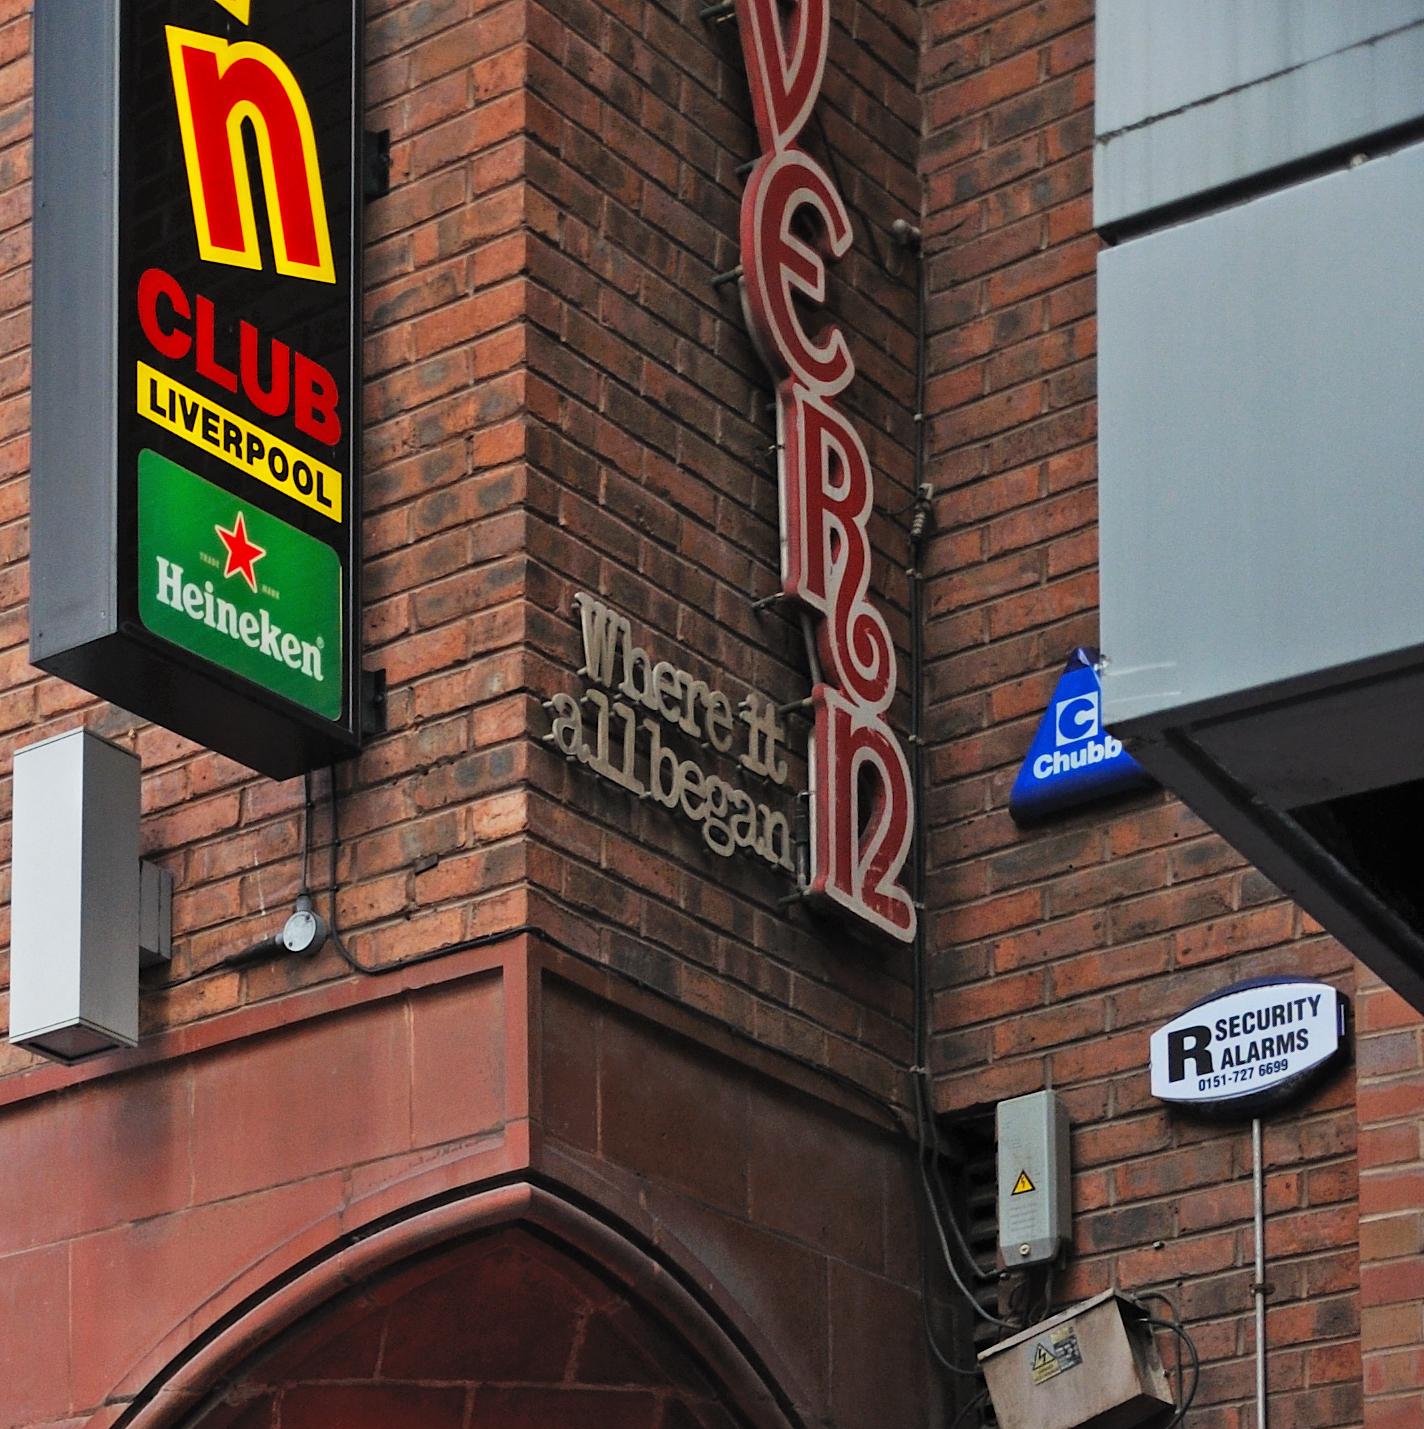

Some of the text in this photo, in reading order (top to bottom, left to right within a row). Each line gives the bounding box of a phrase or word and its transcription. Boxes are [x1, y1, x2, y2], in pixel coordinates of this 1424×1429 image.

[137, 267, 342, 446] CLUB
[149, 377, 332, 509] LIVERPOOL
[156, 555, 324, 681] Heineken
[574, 591, 789, 785] Where it
[551, 688, 796, 873] all began
[1033, 735, 1123, 780] Chubb
[1167, 993, 1322, 1084] R SECURITY
[1198, 1058, 1289, 1092] 0151-727 6699
[1220, 1027, 1309, 1071] ALARMS
